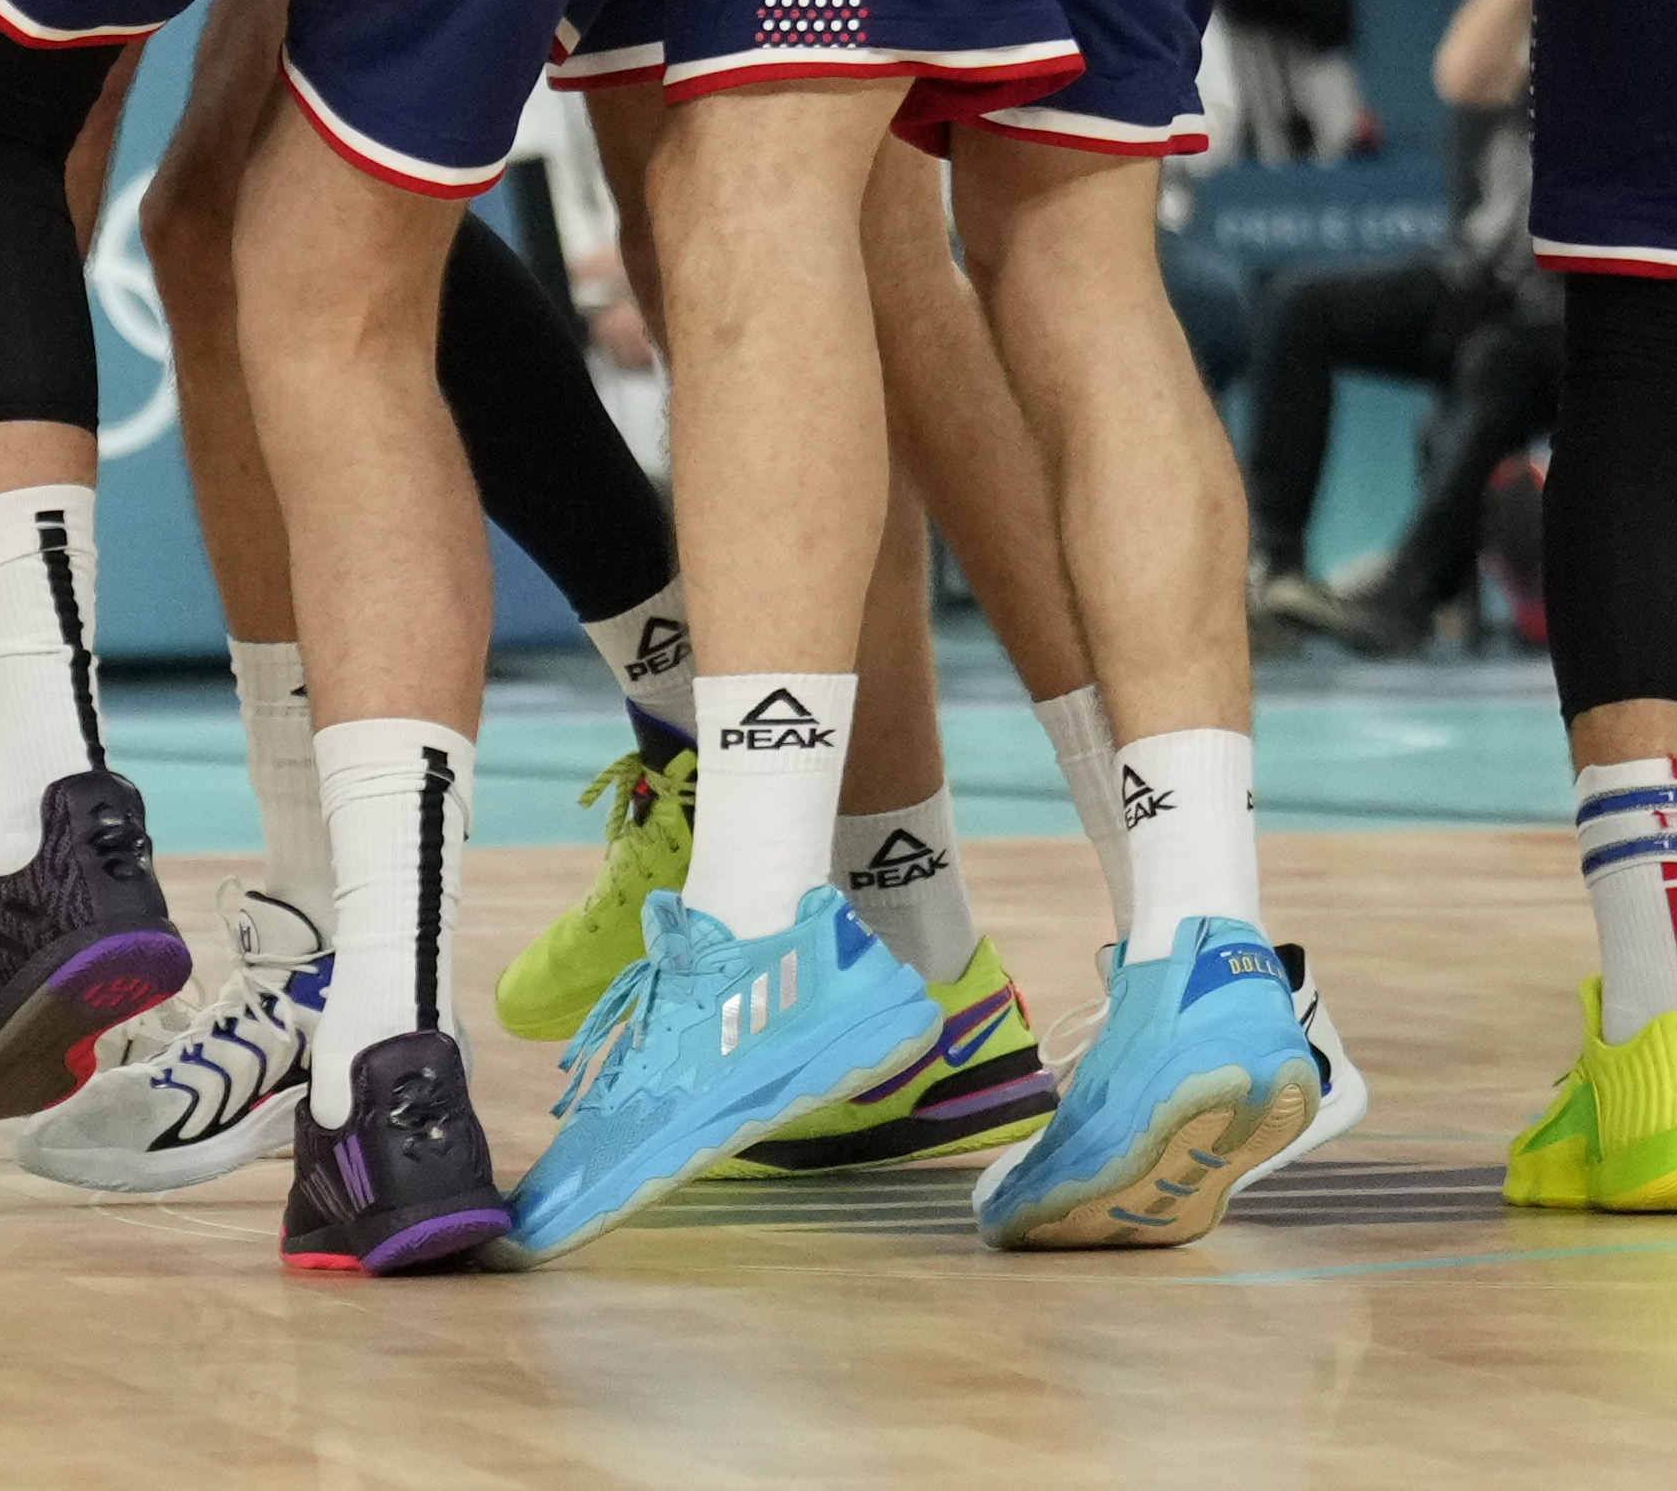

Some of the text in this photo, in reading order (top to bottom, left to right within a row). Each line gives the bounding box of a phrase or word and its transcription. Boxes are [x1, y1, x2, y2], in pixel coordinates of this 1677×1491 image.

[623, 641, 694, 682] PEA
[719, 727, 837, 751] PEAK
[1124, 789, 1178, 832] EAK
[848, 847, 950, 891] PEAK
